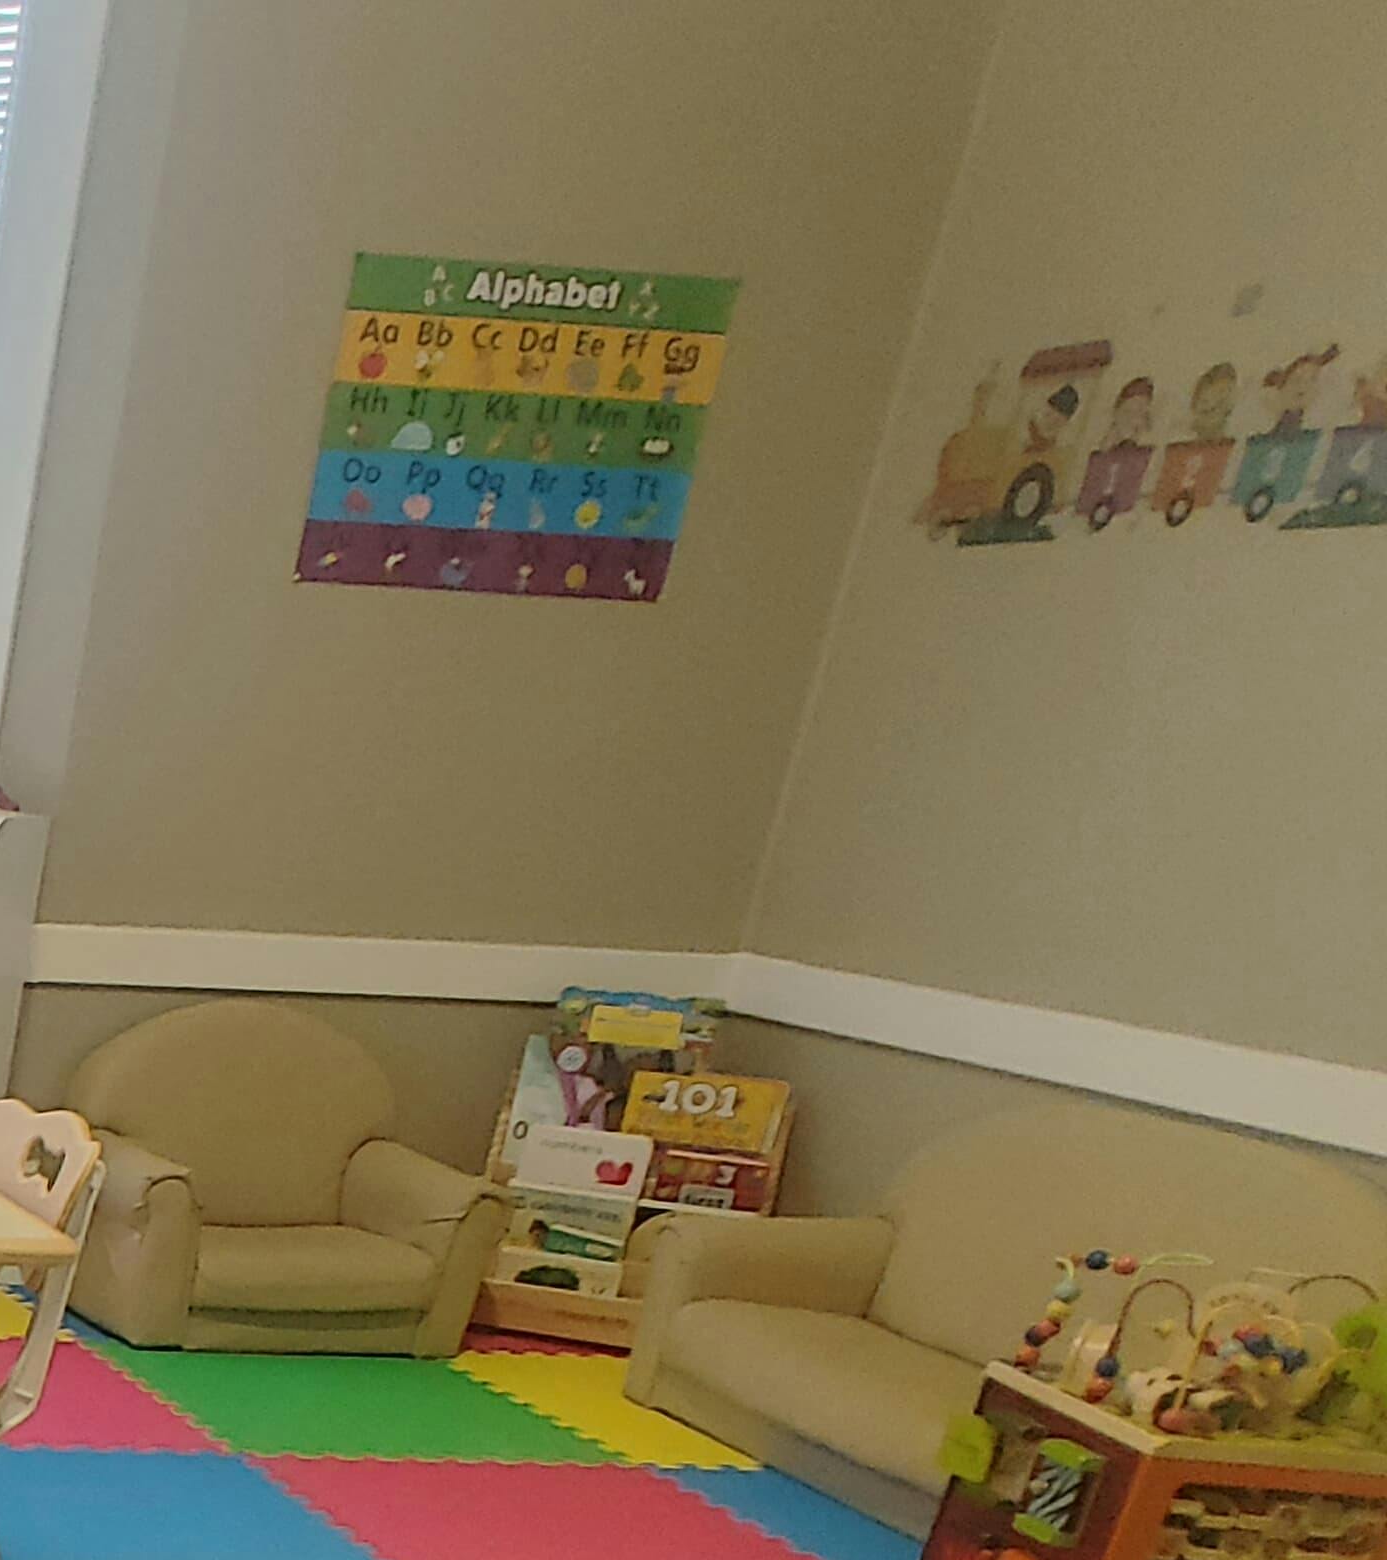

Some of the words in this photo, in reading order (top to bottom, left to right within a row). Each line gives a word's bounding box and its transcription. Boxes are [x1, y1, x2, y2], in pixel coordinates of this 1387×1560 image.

[465, 269, 623, 312] Alphabet
[360, 317, 399, 344] Aa
[417, 320, 453, 347] Bb
[472, 323, 502, 349] Cc
[518, 327, 559, 353] Dd
[574, 330, 605, 357] Ee
[617, 332, 649, 358] Ff
[664, 336, 701, 374] Gg
[350, 387, 388, 414] Hh
[444, 391, 466, 426] Jj
[484, 394, 520, 423] Kk
[535, 397, 560, 424] Ll
[577, 399, 628, 429] Mm
[644, 404, 682, 433] Nn
[342, 457, 382, 485] Oo
[406, 459, 442, 495] Pp
[465, 464, 507, 498] Qq
[529, 468, 559, 494] Rr
[580, 471, 609, 498] Ss
[633, 473, 660, 502] Tt
[658, 1079, 740, 1120] 101
